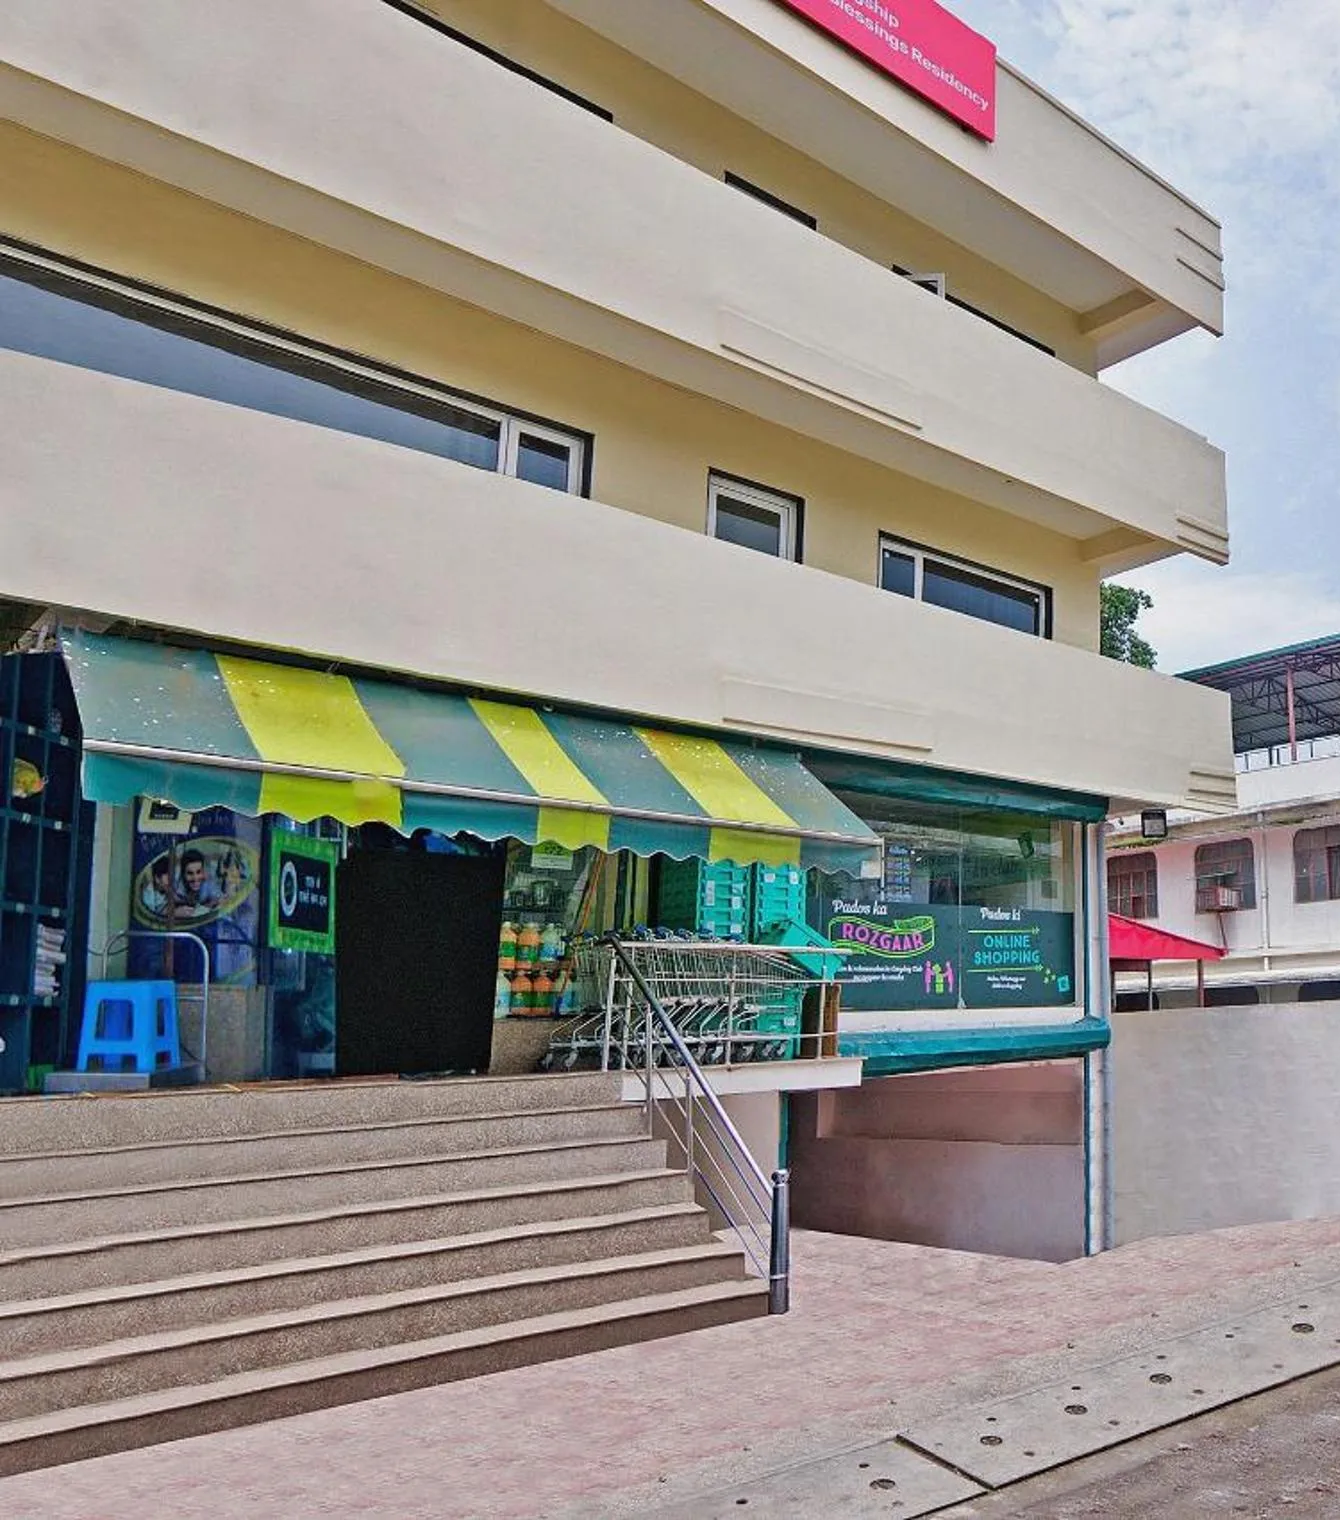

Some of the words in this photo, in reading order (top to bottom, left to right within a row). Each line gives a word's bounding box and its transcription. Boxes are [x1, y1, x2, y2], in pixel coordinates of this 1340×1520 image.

[911, 46, 989, 112] Residency
[872, 900, 888, 915] ka
[842, 922, 924, 951] ROZGAAR
[983, 935, 1030, 948] ONLINE
[974, 950, 1041, 966] SHOPPING
